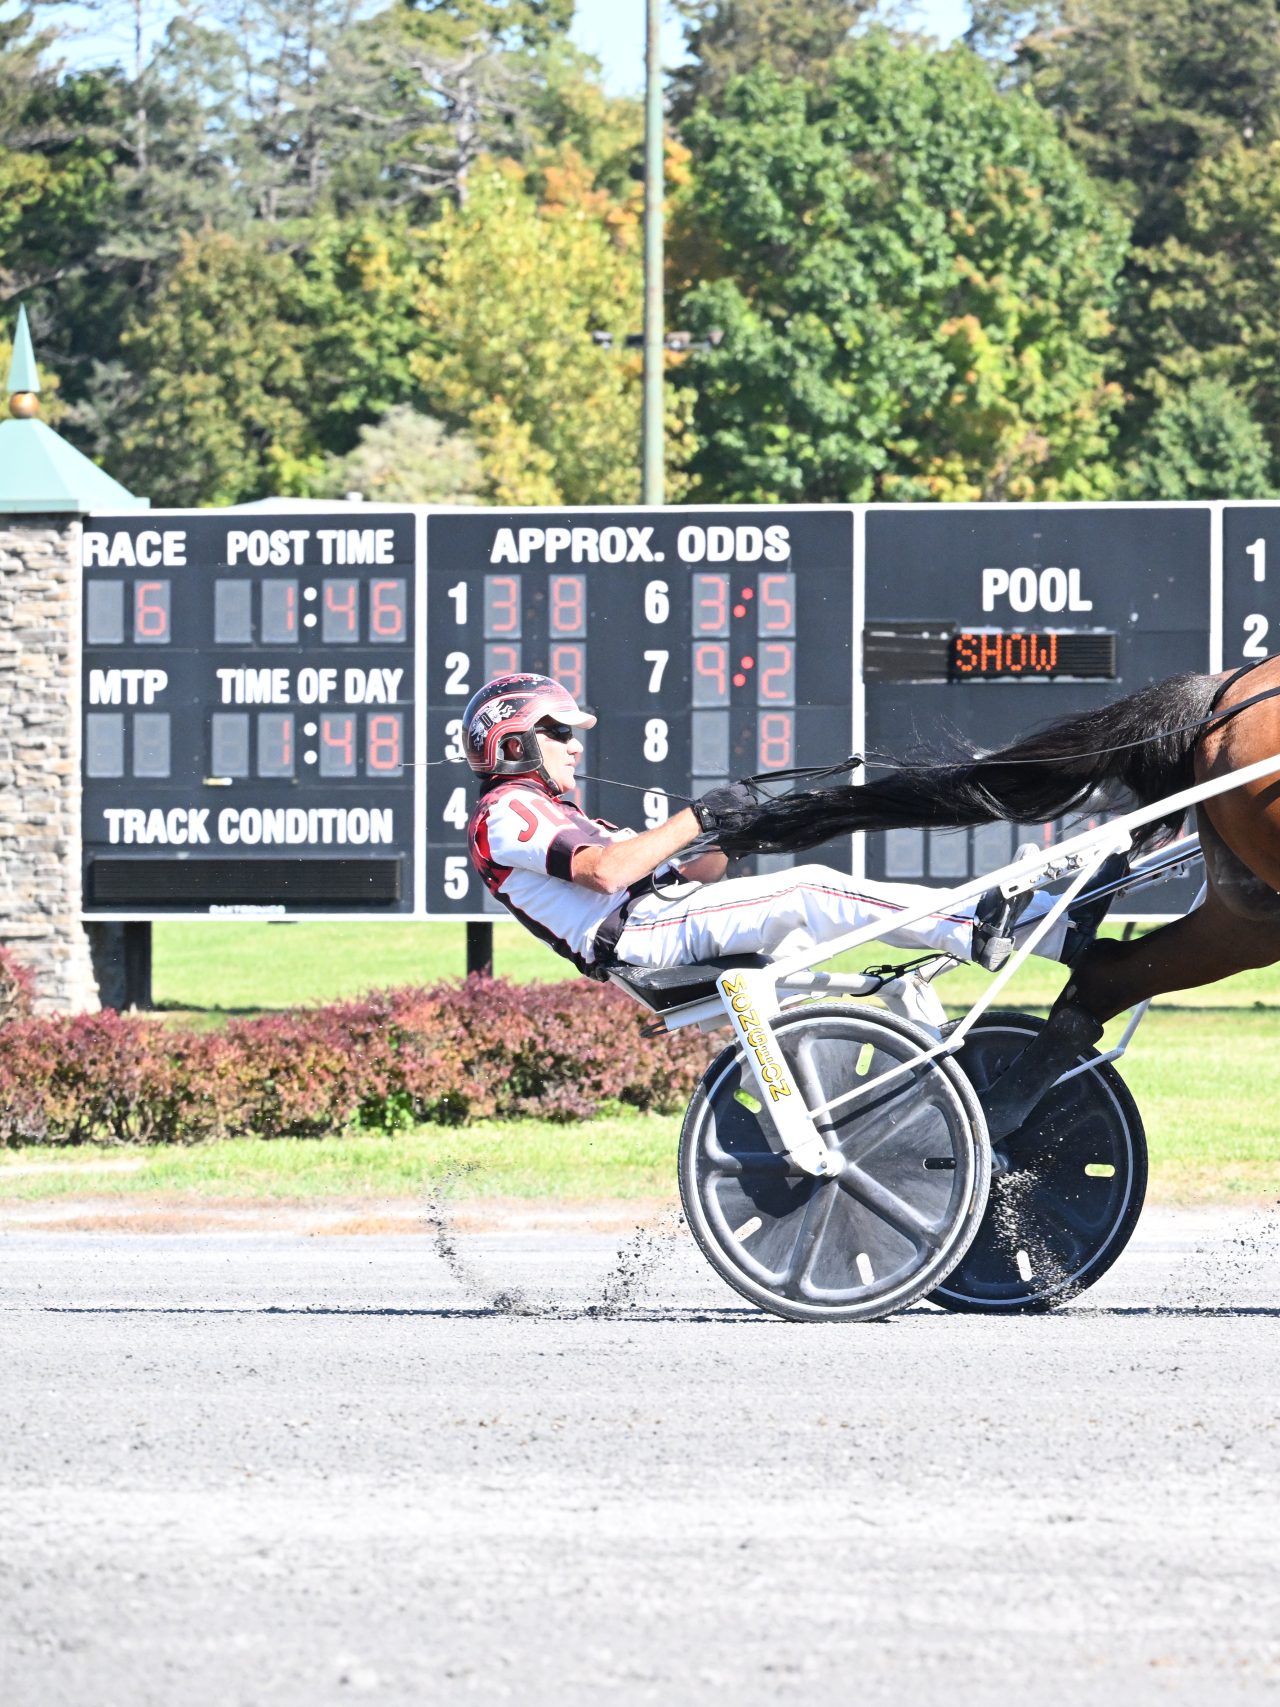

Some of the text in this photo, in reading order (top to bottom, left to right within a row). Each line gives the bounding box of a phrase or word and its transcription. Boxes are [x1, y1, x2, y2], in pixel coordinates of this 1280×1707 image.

[83, 530, 187, 567] RACE
[227, 529, 395, 566] POST TIME
[489, 525, 791, 563] APPROX. ODDS
[1245, 538, 1266, 582] 1
[137, 583, 166, 635] 6
[447, 582, 468, 625] 1
[644, 580, 670, 624] 6
[982, 567, 1093, 613] POOL
[955, 632, 1058, 673] SHOW
[1242, 613, 1269, 658] 2
[89, 669, 168, 705] MTP
[216, 668, 404, 704] TIME OF DAY
[444, 651, 470, 695] 2
[643, 650, 669, 693] 7
[643, 718, 669, 763] 8
[761, 714, 791, 769] 8
[103, 808, 393, 844] TRACK CONDITION
[443, 787, 469, 830] 4
[644, 787, 669, 830] 9
[443, 856, 469, 900] 5
[721, 973, 791, 1102] MONGEON
